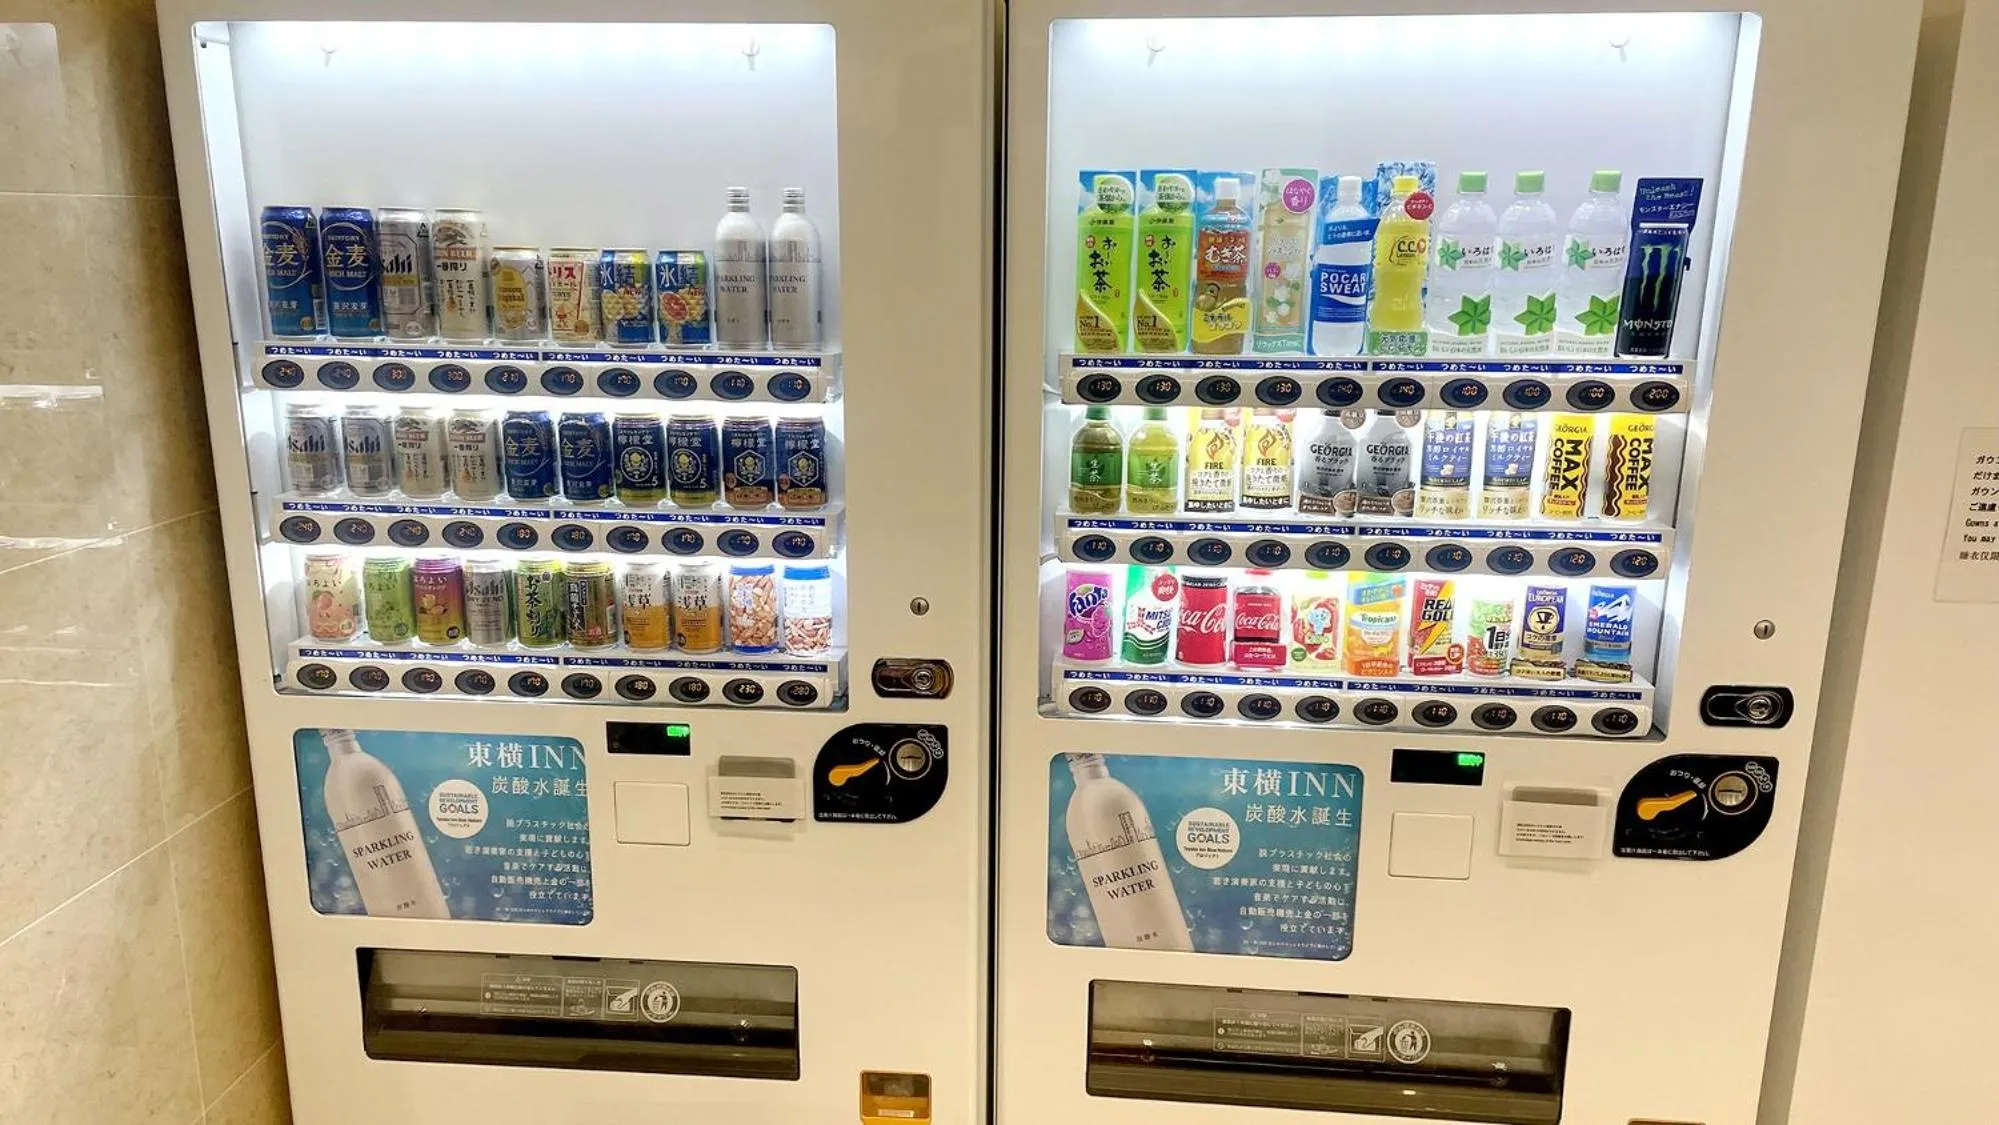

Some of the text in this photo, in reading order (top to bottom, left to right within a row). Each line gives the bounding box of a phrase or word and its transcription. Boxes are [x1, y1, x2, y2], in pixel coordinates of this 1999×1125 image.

[325, 244, 368, 268] 金麦
[1205, 245, 1247, 265] むぎ茶
[1320, 282, 1366, 294] SWEAT
[1156, 381, 1171, 391] 130
[1276, 383, 1292, 393] 130
[1649, 388, 1669, 399] 200
[1205, 462, 1224, 470] FIRE
[1256, 458, 1277, 466] FIRE
[1549, 438, 1564, 490] COFFEE
[1561, 439, 1583, 491] MAX
[1625, 438, 1642, 490] COFFEE
[1638, 438, 1654, 492] MAX
[1965, 518, 1989, 527] Gowns
[1963, 534, 1996, 544] You may
[1587, 628, 1629, 636] MOUNTAIN
[1588, 622, 1627, 630] EMERALD
[634, 680, 648, 690] 180
[739, 684, 755, 694] 230
[491, 776, 587, 798] 炭酸水誕生
[1220, 767, 1356, 799] 東横INN
[439, 803, 479, 814] GOALS
[1245, 805, 1352, 827] 炭酸水誕生
[352, 831, 415, 861] SPARKLING
[1187, 833, 1230, 844] GOALS
[367, 849, 412, 872] WATER
[1092, 859, 1159, 888] SPARKLING
[1106, 879, 1156, 902] WATER
